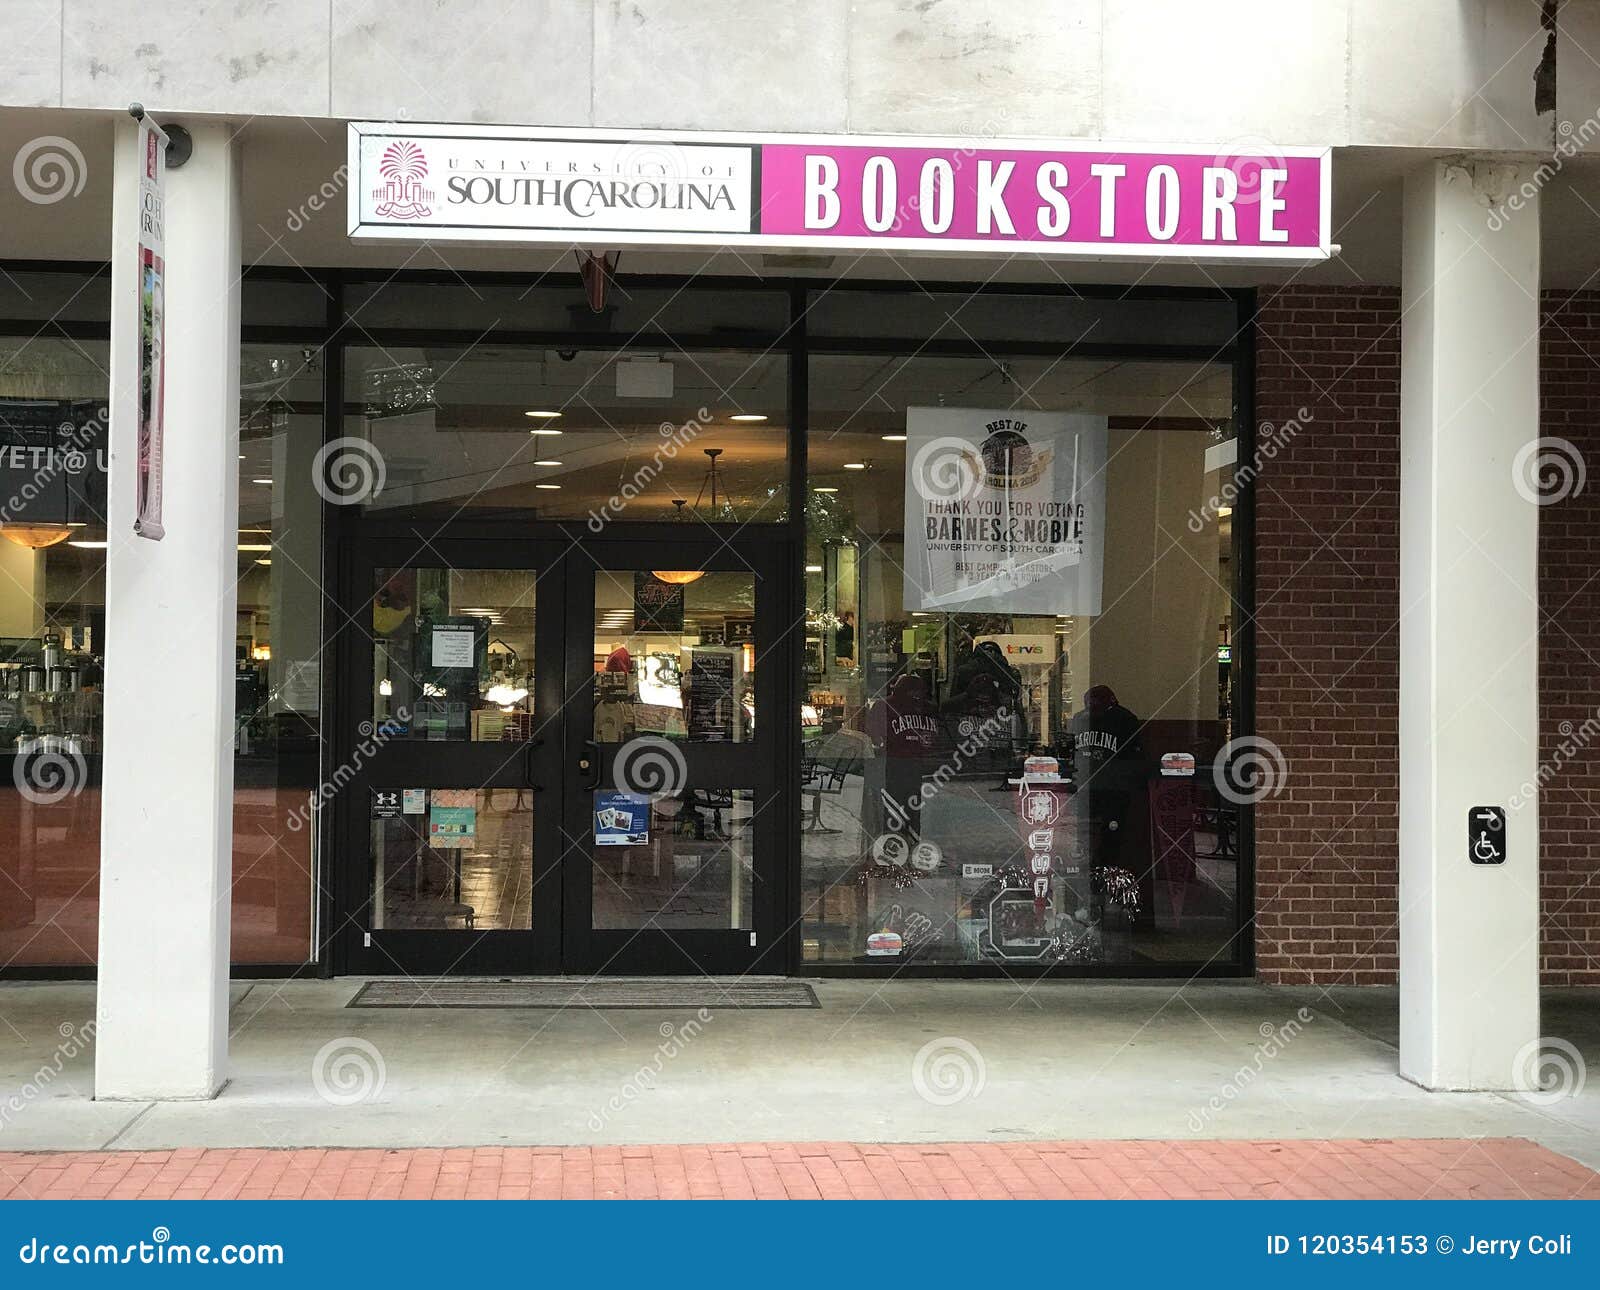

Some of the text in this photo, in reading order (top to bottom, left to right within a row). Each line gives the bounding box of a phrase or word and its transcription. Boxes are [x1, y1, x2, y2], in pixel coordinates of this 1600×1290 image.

[449, 158, 670, 176] UNIVERSITY
[803, 154, 1289, 243] BOOKSTORE
[986, 419, 1028, 434] BEST OF
[0, 445, 54, 469] YETI
[63, 450, 87, 474] @
[927, 500, 1084, 518] THANK YOU FOR VOTING
[927, 543, 982, 552] UNIVERSITY
[985, 544, 998, 552] OF
[1000, 544, 1033, 553] SOUTH
[977, 562, 1006, 572] CAMP
[891, 714, 938, 735] CAROLIN
[1075, 730, 1117, 752] CAROLINA
